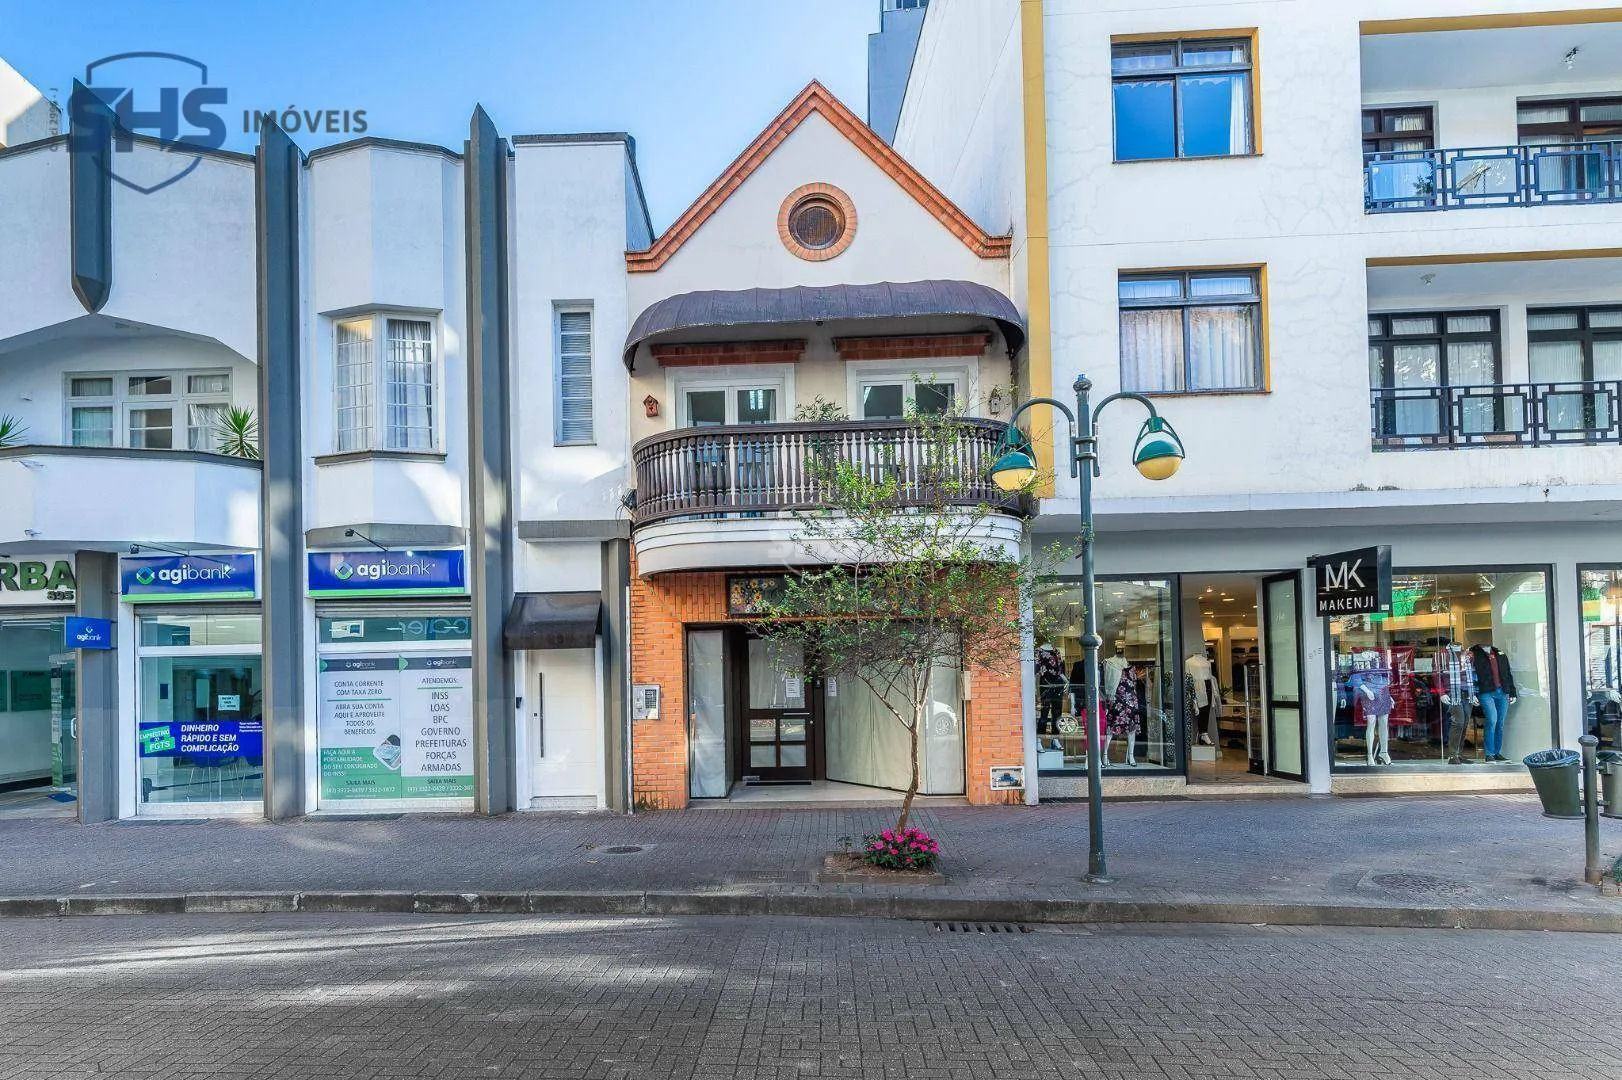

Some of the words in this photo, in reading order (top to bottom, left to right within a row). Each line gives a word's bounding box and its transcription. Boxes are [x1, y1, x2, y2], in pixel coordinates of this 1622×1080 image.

[158, 564, 233, 585] agibank
[356, 559, 432, 580] agibank
[1325, 558, 1366, 592] MK
[1319, 595, 1374, 611] MAKENJI
[76, 633, 102, 642] agibank
[355, 680, 384, 688] CORRENTE
[431, 691, 449, 700] INSS
[430, 703, 450, 712] LOAS
[433, 715, 449, 724] BPC
[180, 724, 220, 732] DINHEIRO
[421, 727, 461, 736] GOVERNO
[180, 732, 210, 742] RÁPIDO
[211, 734, 218, 742] E
[219, 734, 237, 742] SEM
[149, 740, 171, 751] FGTS
[415, 738, 467, 748] PREFEITURAS
[180, 743, 239, 754] COMPLICAÇÃO
[425, 751, 457, 762] FORÇAS
[421, 762, 462, 772] ARMADAS
